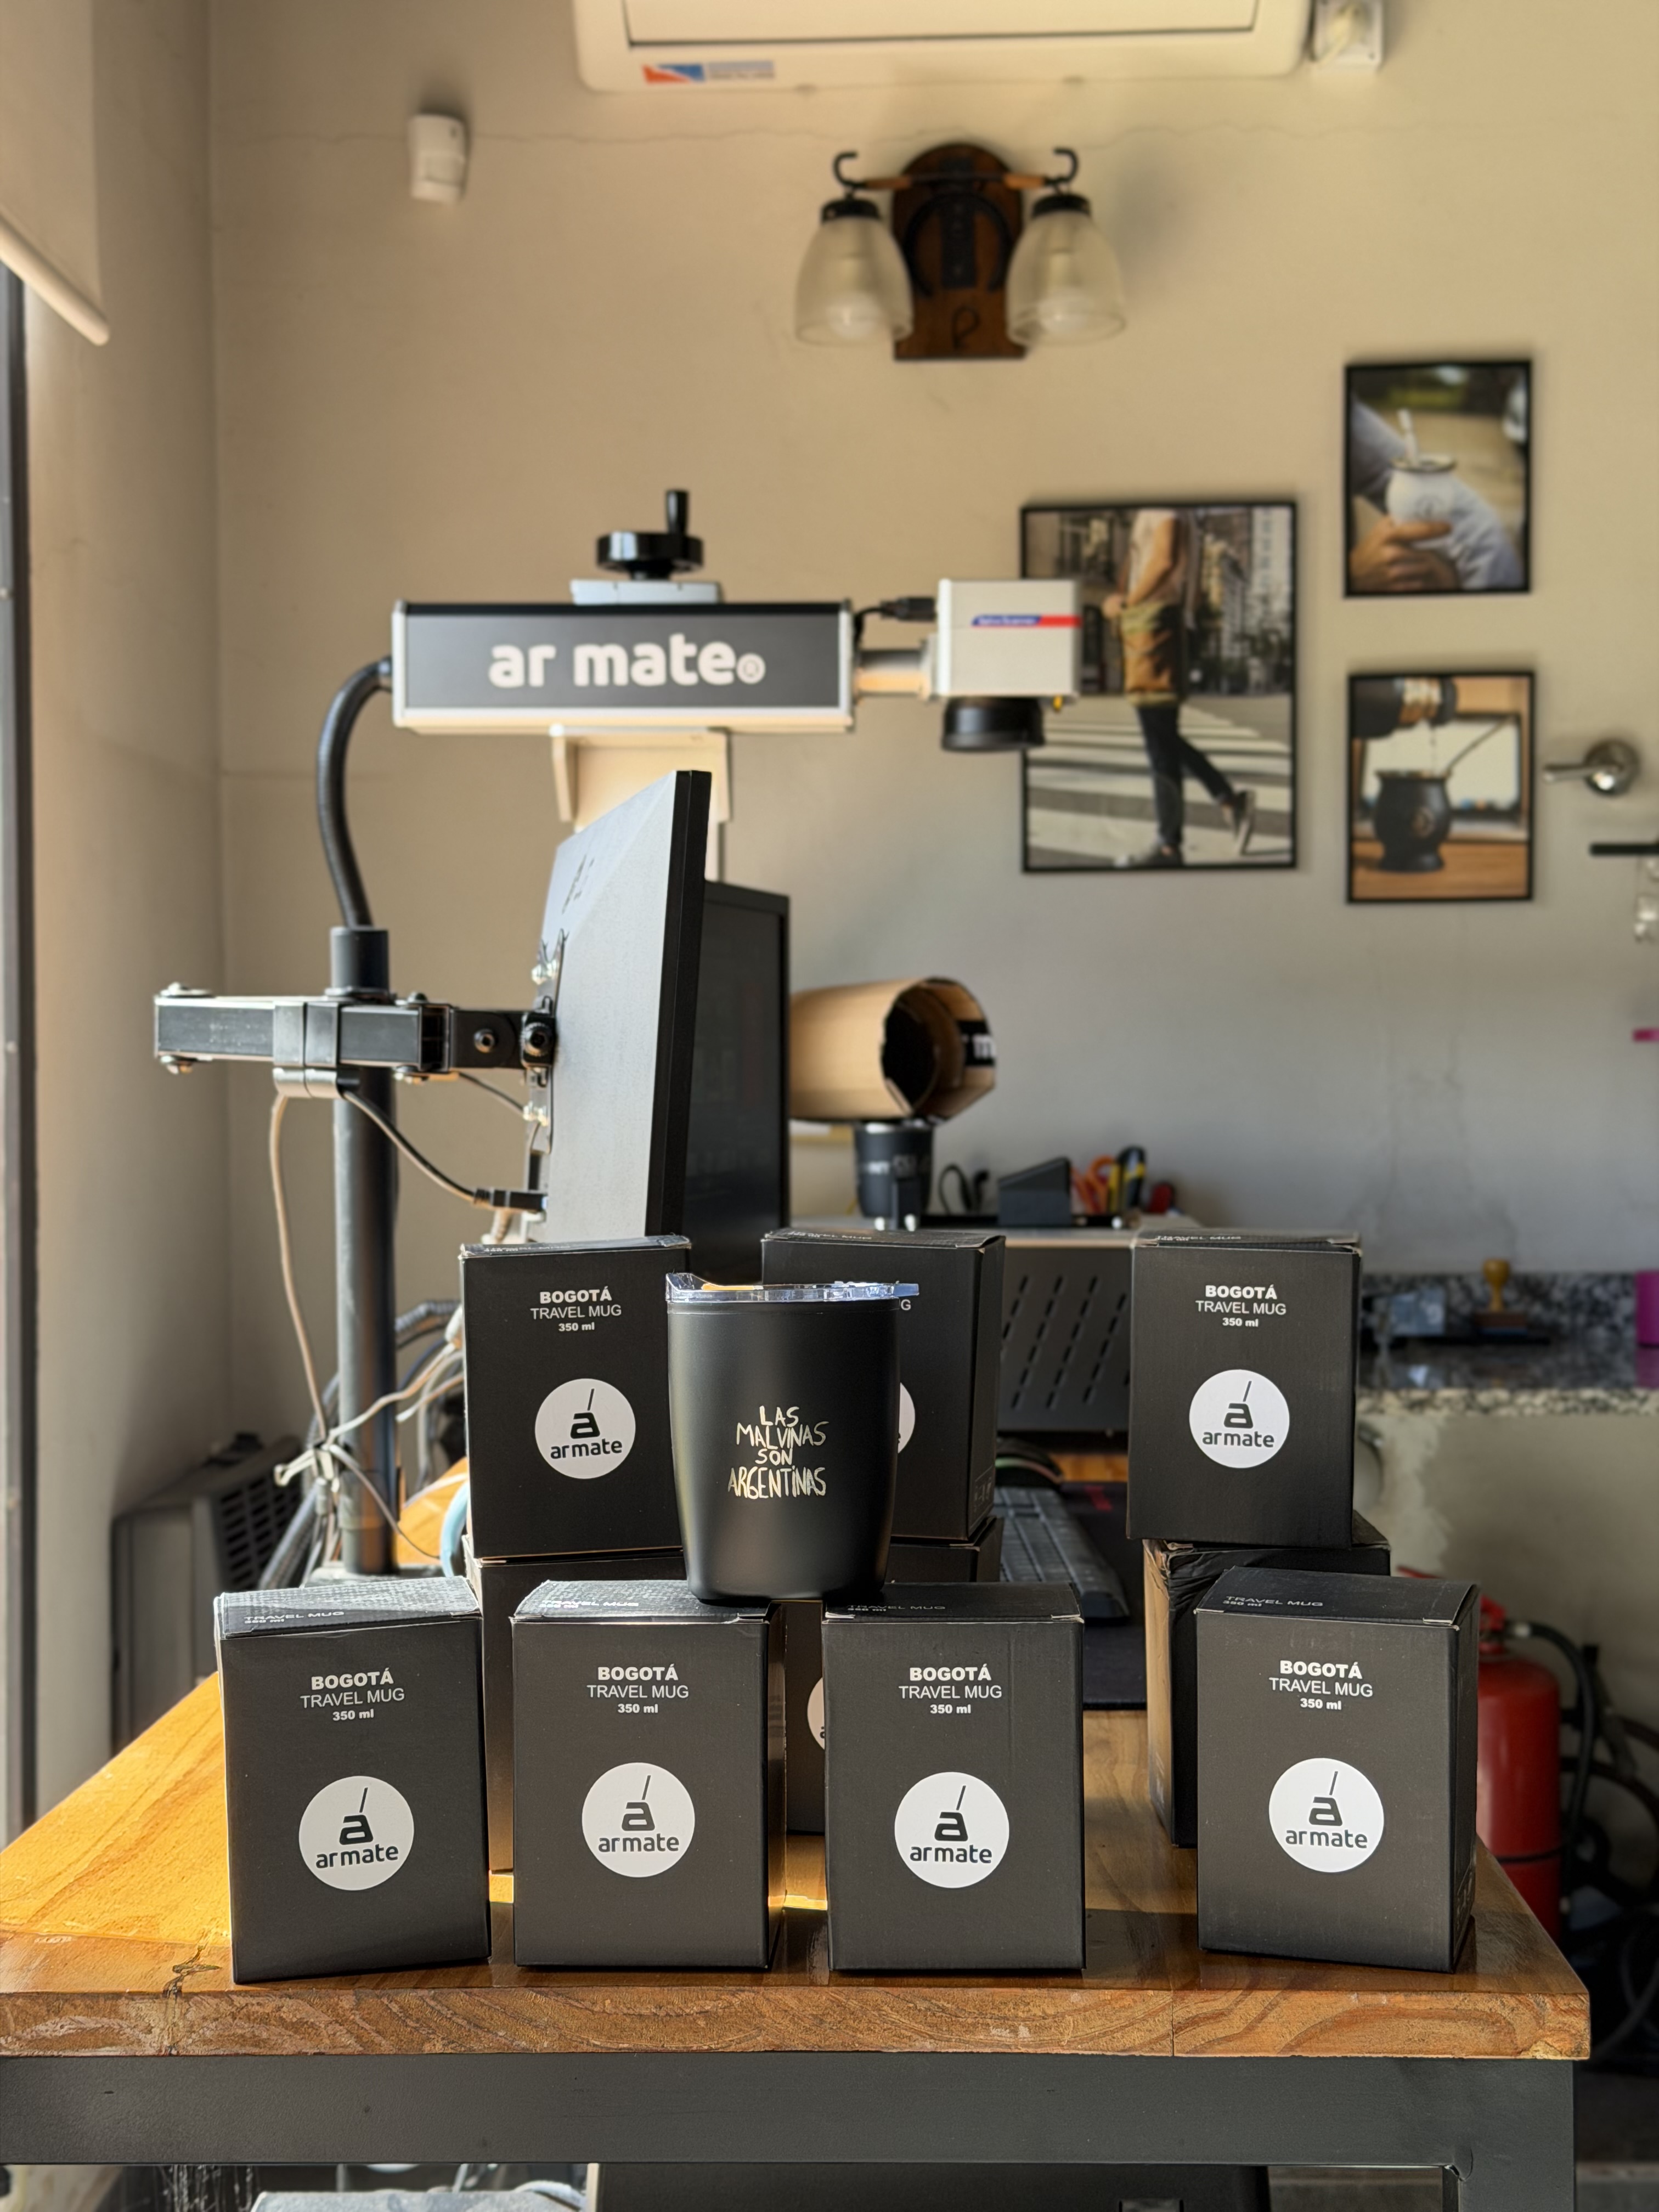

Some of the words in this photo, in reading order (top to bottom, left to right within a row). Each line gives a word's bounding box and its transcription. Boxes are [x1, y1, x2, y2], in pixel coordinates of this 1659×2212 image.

[487, 644, 557, 689] ar
[540, 1286, 612, 1304] BOGOTÁ
[1205, 1285, 1277, 1300] BOGOTÁ
[530, 1306, 585, 1320] TRAVEL
[589, 1304, 622, 1317] MUG
[1195, 1300, 1250, 1314] TRAVEL
[1253, 1302, 1286, 1316] MUG
[558, 1323, 579, 1331] 350
[582, 1322, 595, 1331] ml
[1222, 1317, 1243, 1327] 350
[1245, 1318, 1259, 1327] ml
[759, 1406, 799, 1427] LAS
[736, 1421, 829, 1449] MALVINAS
[1202, 1431, 1274, 1448] armate
[550, 1438, 623, 1459] armate
[754, 1448, 793, 1466] SON
[1226, 1596, 1283, 1605] TRAVEL
[311, 1667, 394, 1690] BOGOTÁ
[597, 1663, 679, 1681] BOGOTÁ
[910, 1663, 992, 1681] BOGOTÁ
[1280, 1660, 1363, 1679] BOGOTÁ
[586, 1685, 648, 1698] TRAVEL
[652, 1685, 689, 1699] MUG
[898, 1685, 961, 1699] TRAVEL
[964, 1685, 1002, 1699] MUG
[1268, 1677, 1331, 1695] TRAVEL
[1335, 1681, 1373, 1697] MUG
[300, 1691, 363, 1708] TRAVEL
[367, 1688, 405, 1703] MUG
[1300, 1697, 1323, 1709] 350
[1326, 1700, 1342, 1711] ml
[332, 1710, 356, 1721] 350
[359, 1708, 374, 1719] ml
[618, 1703, 640, 1713] 350
[643, 1703, 658, 1713] ml
[930, 1704, 953, 1714] 350
[956, 1704, 971, 1714] ml
[598, 1833, 679, 1853] armate
[1285, 1829, 1368, 1849] armate
[315, 1844, 399, 1869] armate
[910, 1844, 992, 1864] armate
